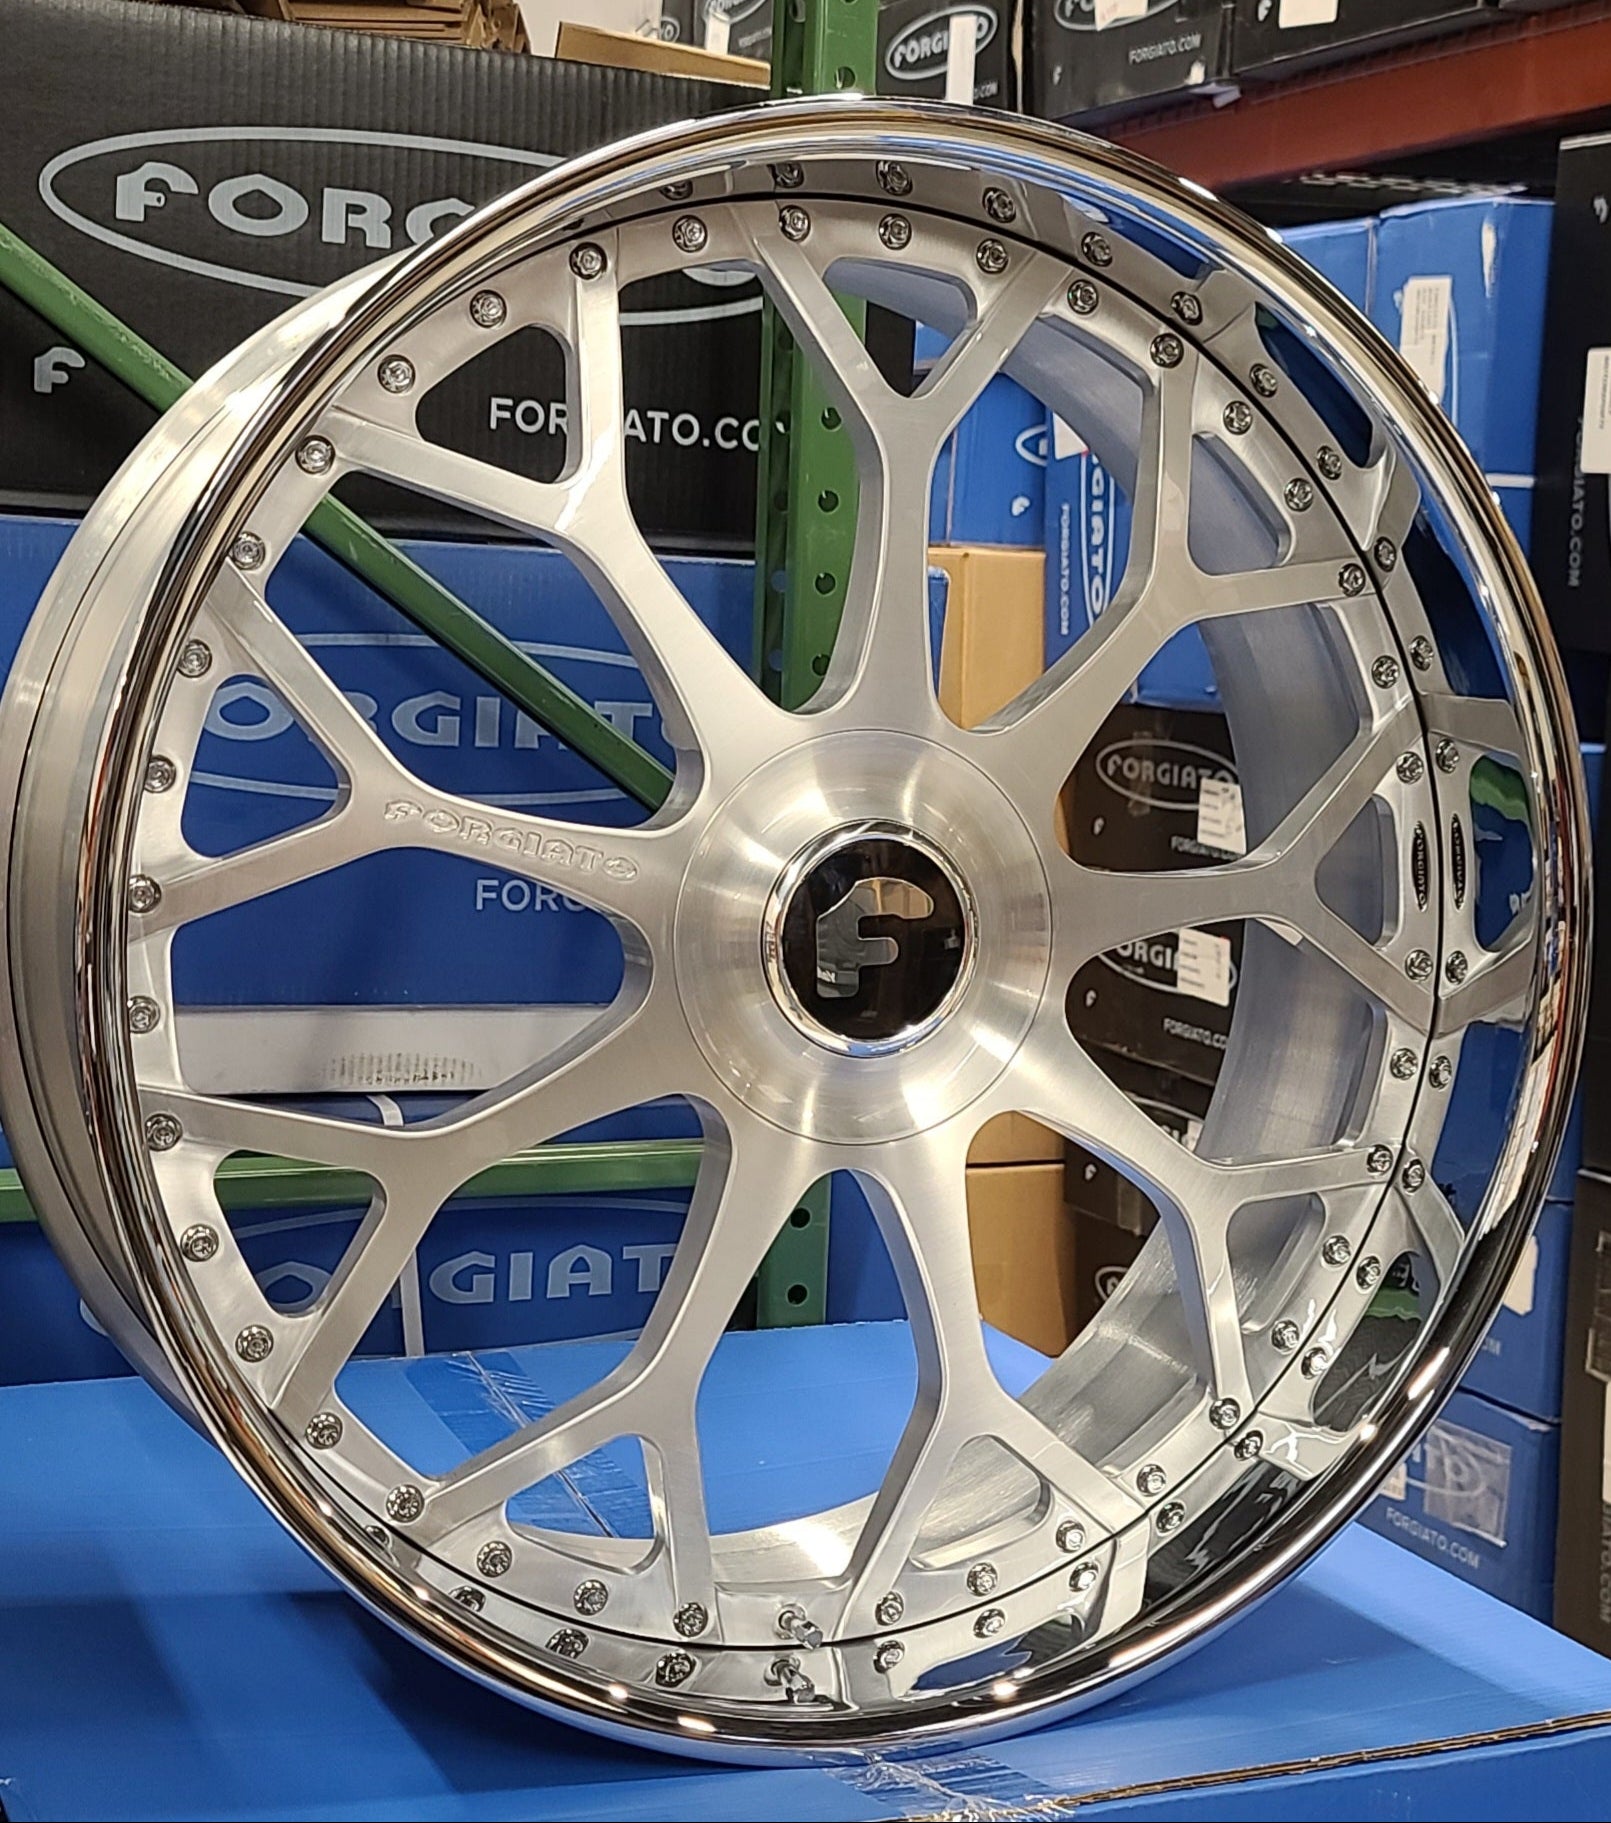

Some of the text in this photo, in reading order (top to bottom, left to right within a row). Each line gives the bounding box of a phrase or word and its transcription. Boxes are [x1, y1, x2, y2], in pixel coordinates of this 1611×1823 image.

[894, 17, 989, 68] FORGIO
[1129, 34, 1201, 63] FORGIATO.COM
[115, 161, 475, 249] FORG
[34, 347, 86, 392] F
[489, 397, 760, 452] FORATO.CO
[1061, 503, 1070, 635] FORGIATO.COM
[1091, 462, 1104, 615] GIATO
[384, 800, 640, 882] FORGIATO
[816, 877, 934, 997] F
[1164, 1018, 1228, 1049] FORGIATO.CO
[1386, 1507, 1480, 1568] FORGIATO.COM
